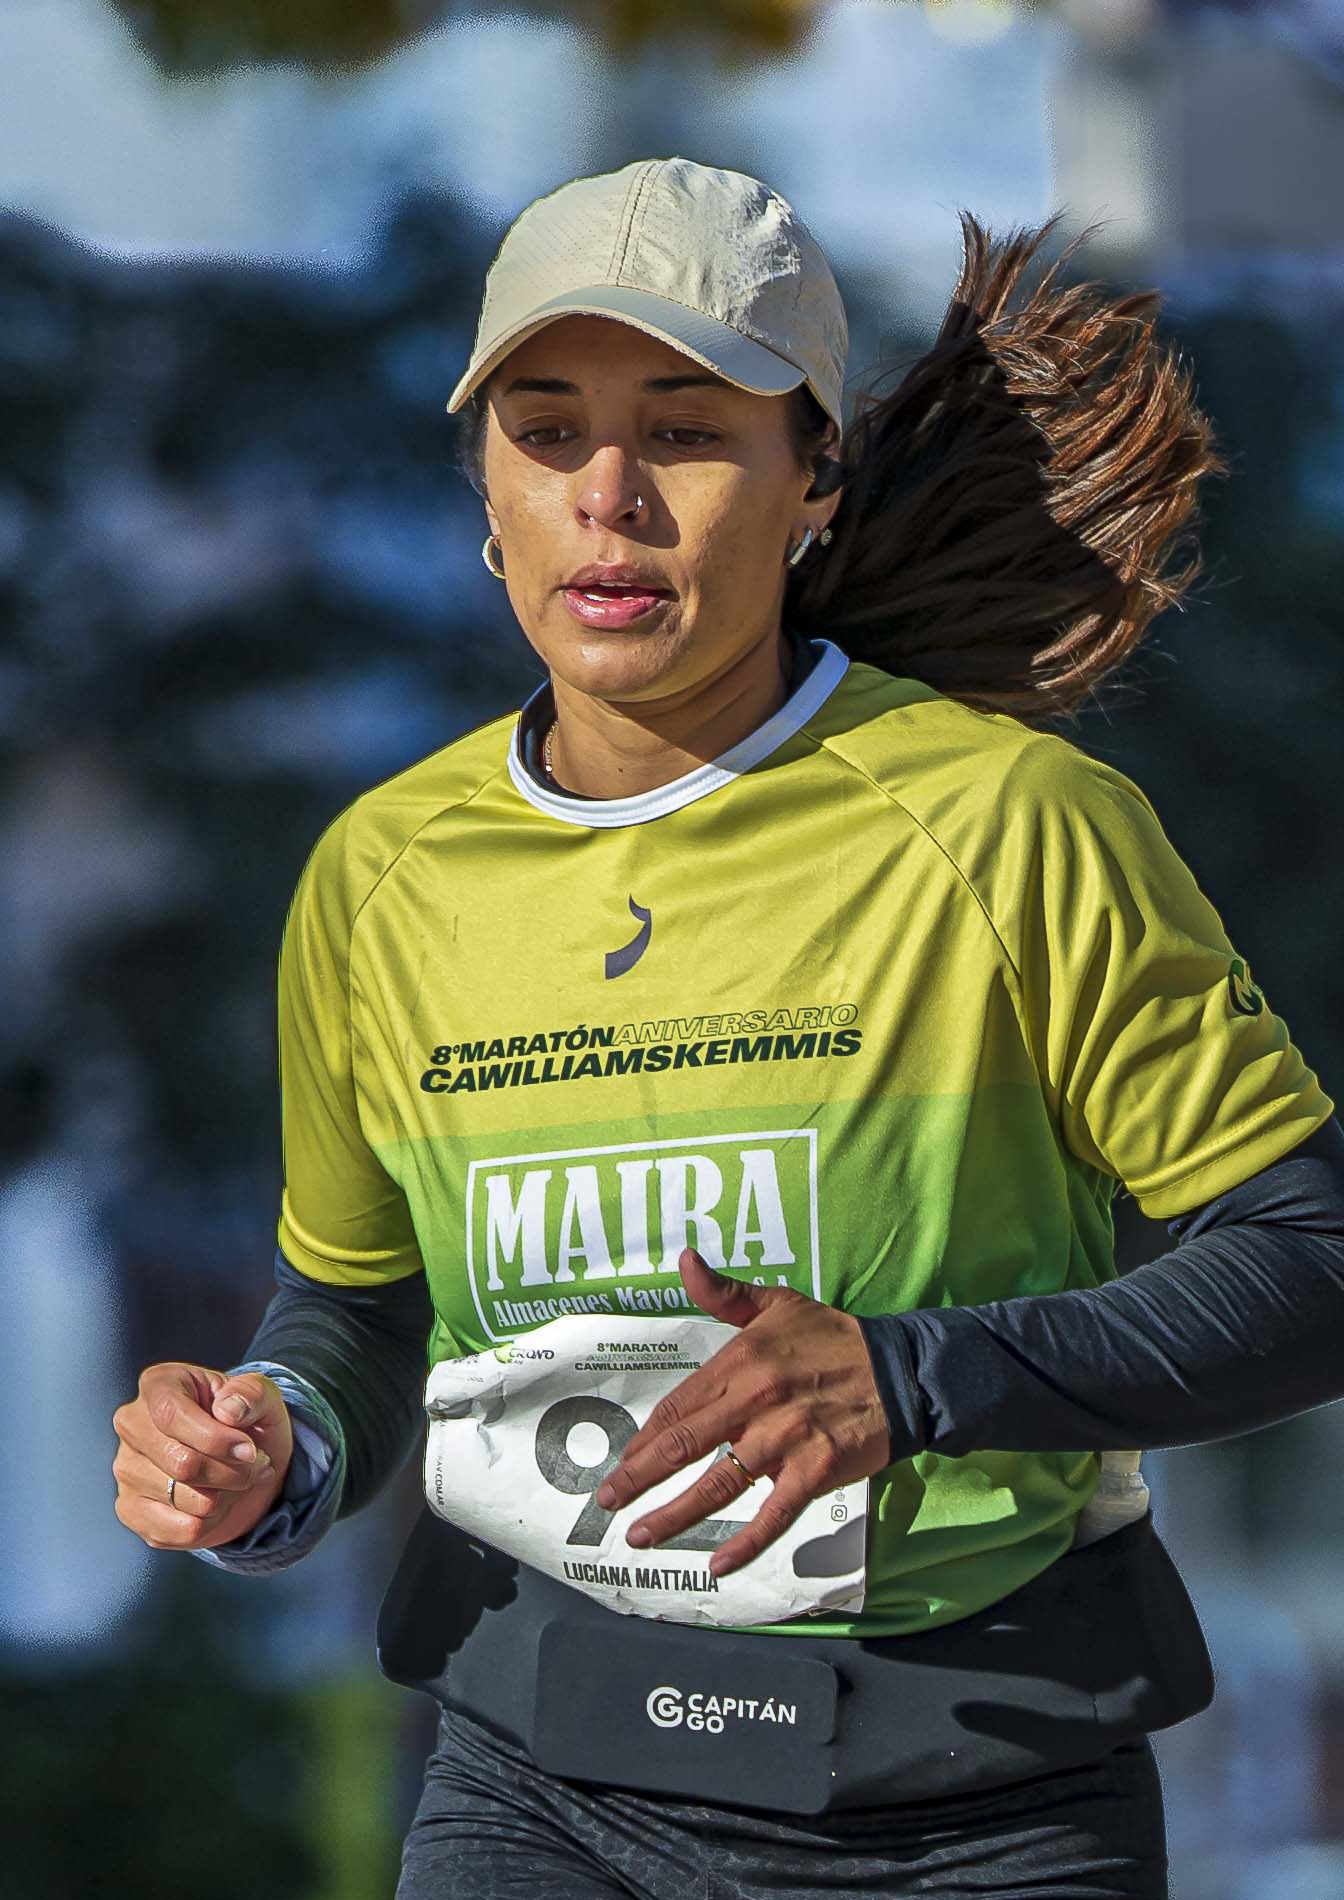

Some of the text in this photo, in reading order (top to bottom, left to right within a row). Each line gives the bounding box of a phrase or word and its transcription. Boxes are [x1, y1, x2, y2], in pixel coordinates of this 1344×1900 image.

[419, 1029, 863, 1094] CAWILLIAMSKEMMIS
[484, 1149, 796, 1292] MAIRA
[491, 1285, 697, 1328] Almacenes Mayor
[574, 1361, 702, 1371] CAWILLIAMSKEMMIS
[563, 1561, 719, 1593] LUCIANA MATTALIA
[686, 1712, 725, 1734] GO
[688, 1693, 796, 1725] CAPITÁN
